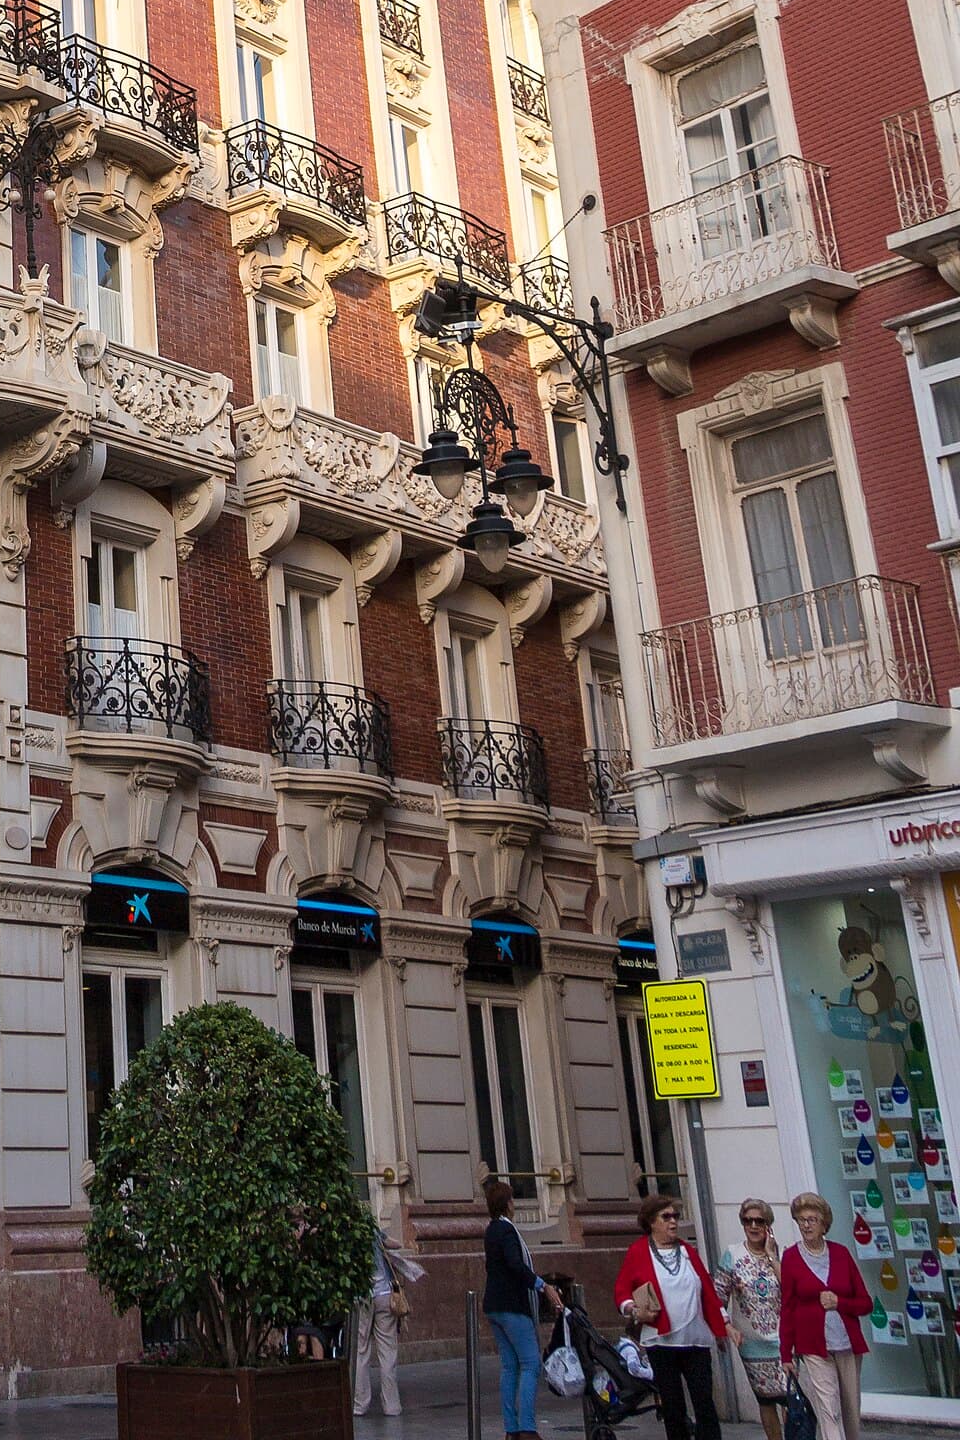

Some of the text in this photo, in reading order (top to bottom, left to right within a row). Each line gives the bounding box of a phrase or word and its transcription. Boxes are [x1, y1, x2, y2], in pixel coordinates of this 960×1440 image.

[298, 918, 357, 936] Banco de Murcia
[635, 957, 642, 969] de
[654, 995, 688, 1003] AUTORIZADA
[650, 1012, 669, 1020] CARGA
[675, 1009, 705, 1018] DESCARGA
[663, 1027, 678, 1035] TODA
[688, 1026, 704, 1034] ZONA
[663, 1043, 699, 1051] RESIDENCIAL
[656, 1060, 665, 1068] DE
